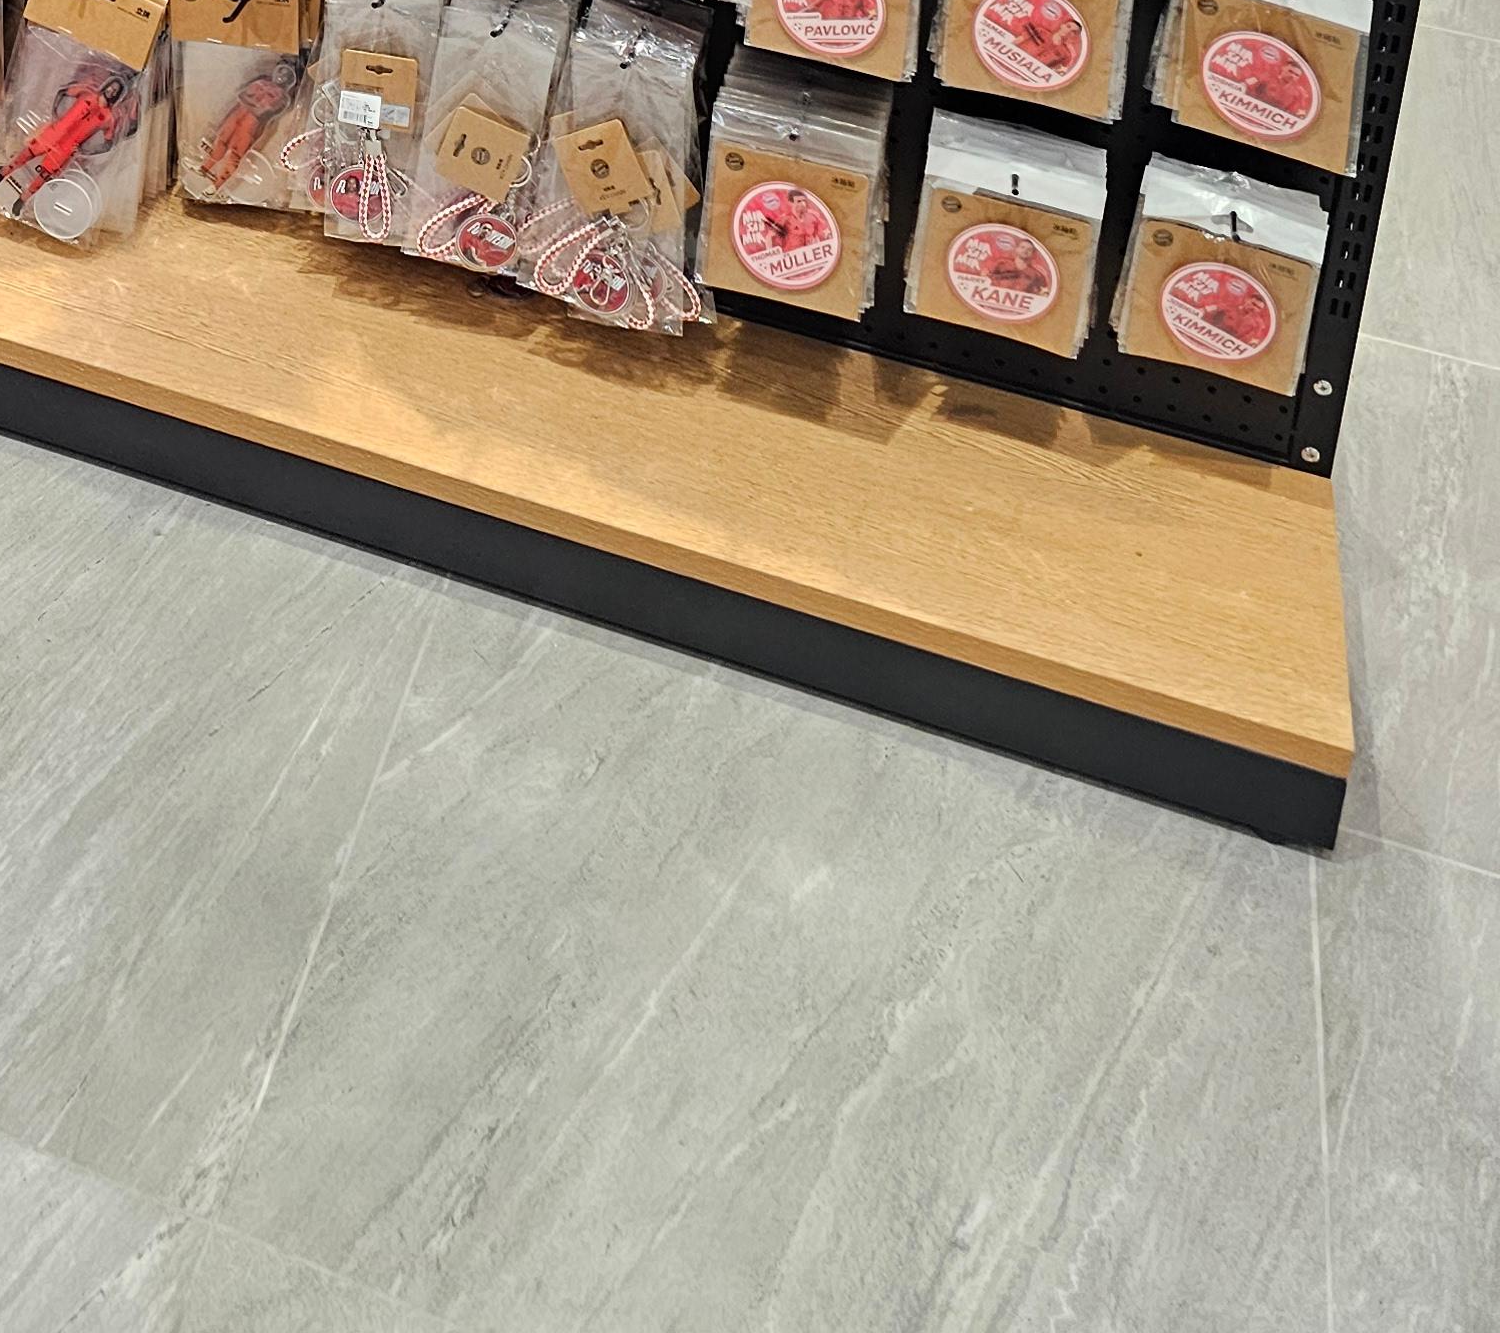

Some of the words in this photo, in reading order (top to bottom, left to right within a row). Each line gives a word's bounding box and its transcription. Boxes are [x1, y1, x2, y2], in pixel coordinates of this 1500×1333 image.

[804, 21, 877, 37] PAVLOVIĆ
[984, 34, 1054, 85] MUSIALA
[1218, 89, 1299, 130] KIMMICH
[768, 243, 835, 276] MÜLLER
[971, 285, 1036, 310] KANE
[1173, 313, 1249, 356] KIMMICH
